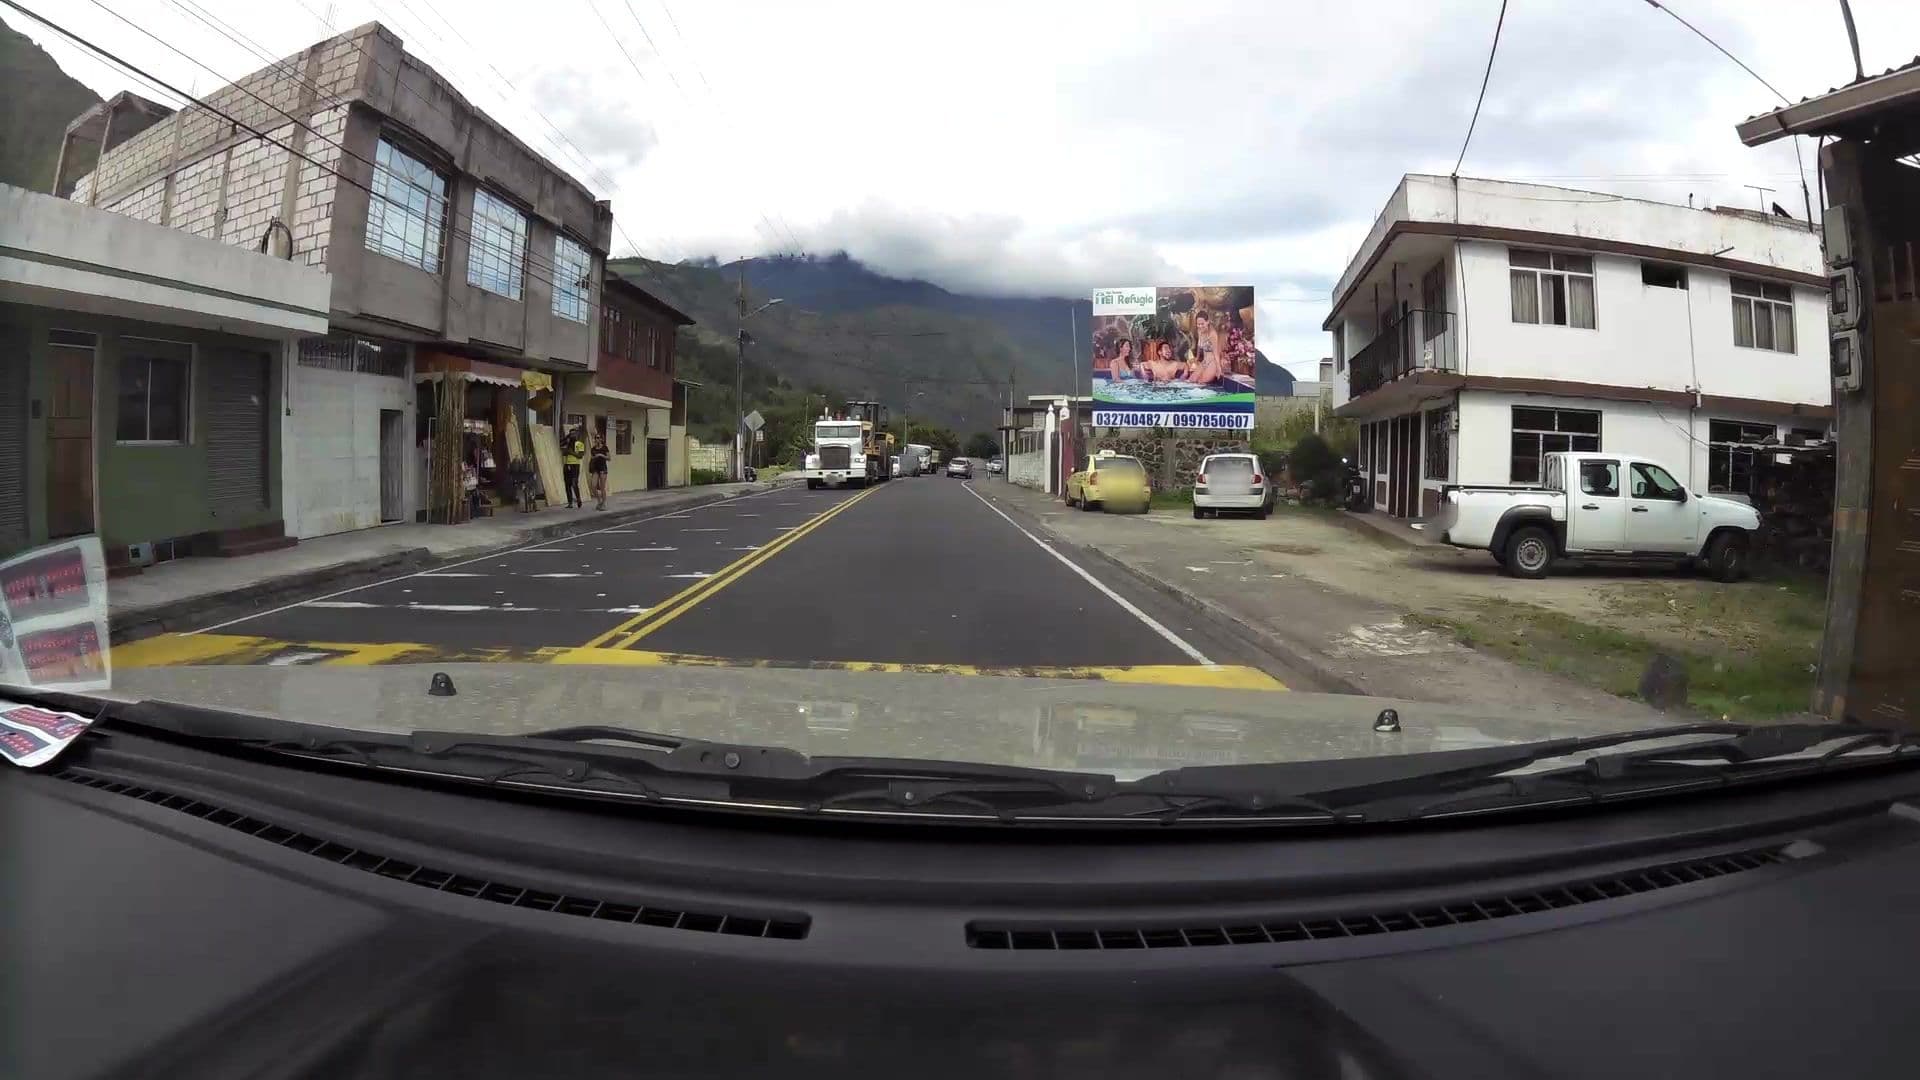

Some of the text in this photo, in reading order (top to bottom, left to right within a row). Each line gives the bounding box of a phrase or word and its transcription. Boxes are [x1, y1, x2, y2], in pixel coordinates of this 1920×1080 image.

[1117, 294, 1154, 307] Refugio
[1096, 413, 1161, 426] 032740482
[1172, 413, 1249, 428] 0997850607
